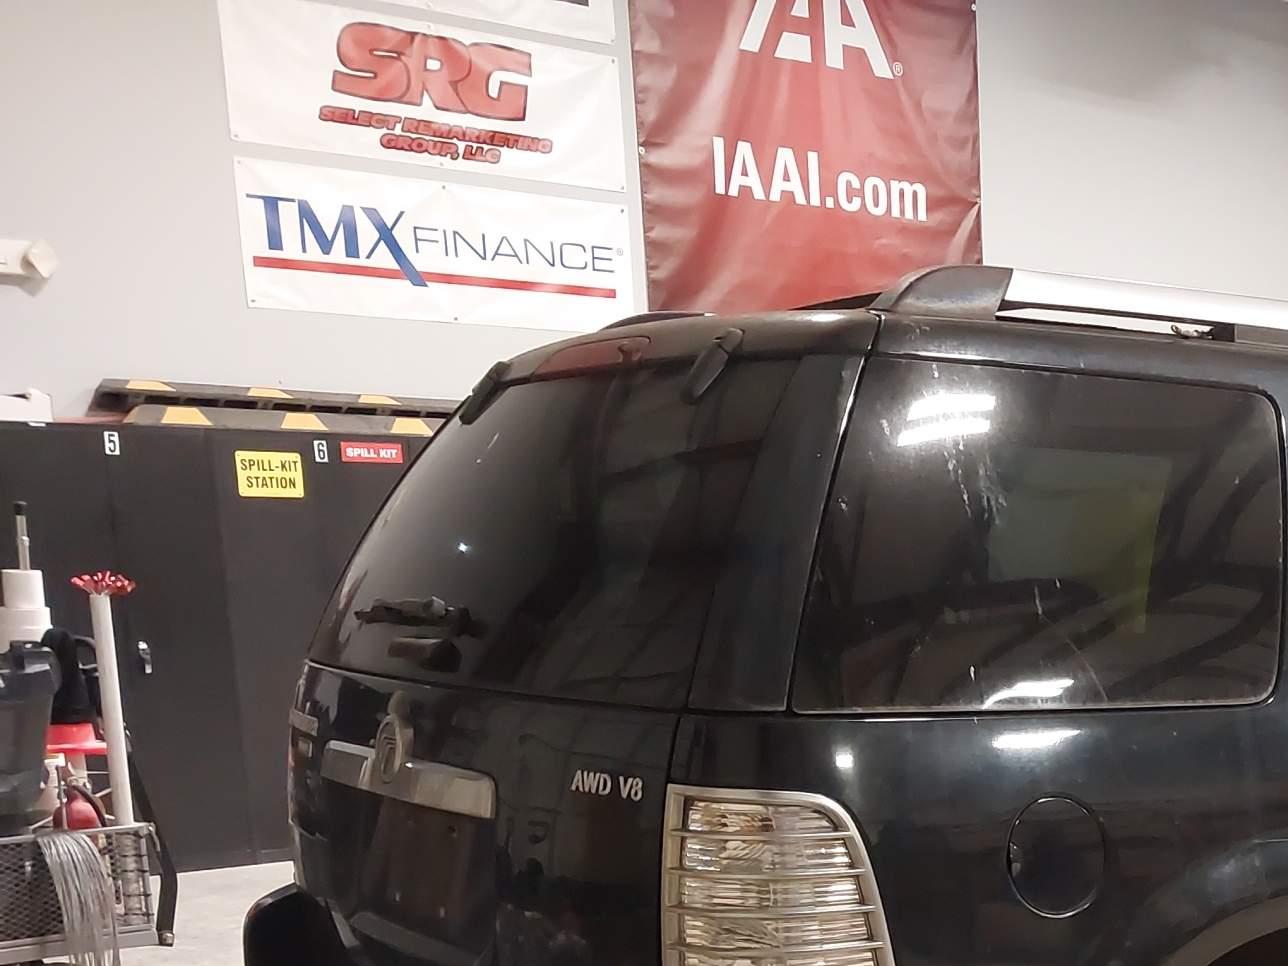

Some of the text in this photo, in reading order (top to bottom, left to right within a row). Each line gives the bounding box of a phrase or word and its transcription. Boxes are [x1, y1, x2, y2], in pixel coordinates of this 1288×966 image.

[331, 22, 532, 121] SRG
[319, 105, 553, 153] SELECT REMARKETING
[380, 133, 501, 164] GROUP, LLC
[712, 136, 928, 221] IAAI.com
[246, 193, 617, 288] TMX FINANCE
[107, 433, 117, 453] 5
[315, 443, 326, 460] 6
[346, 447, 398, 458] SPILL KIT
[240, 459, 298, 473] SPILL-KIT
[246, 476, 297, 489] STATION
[571, 770, 643, 802] AWD V8
